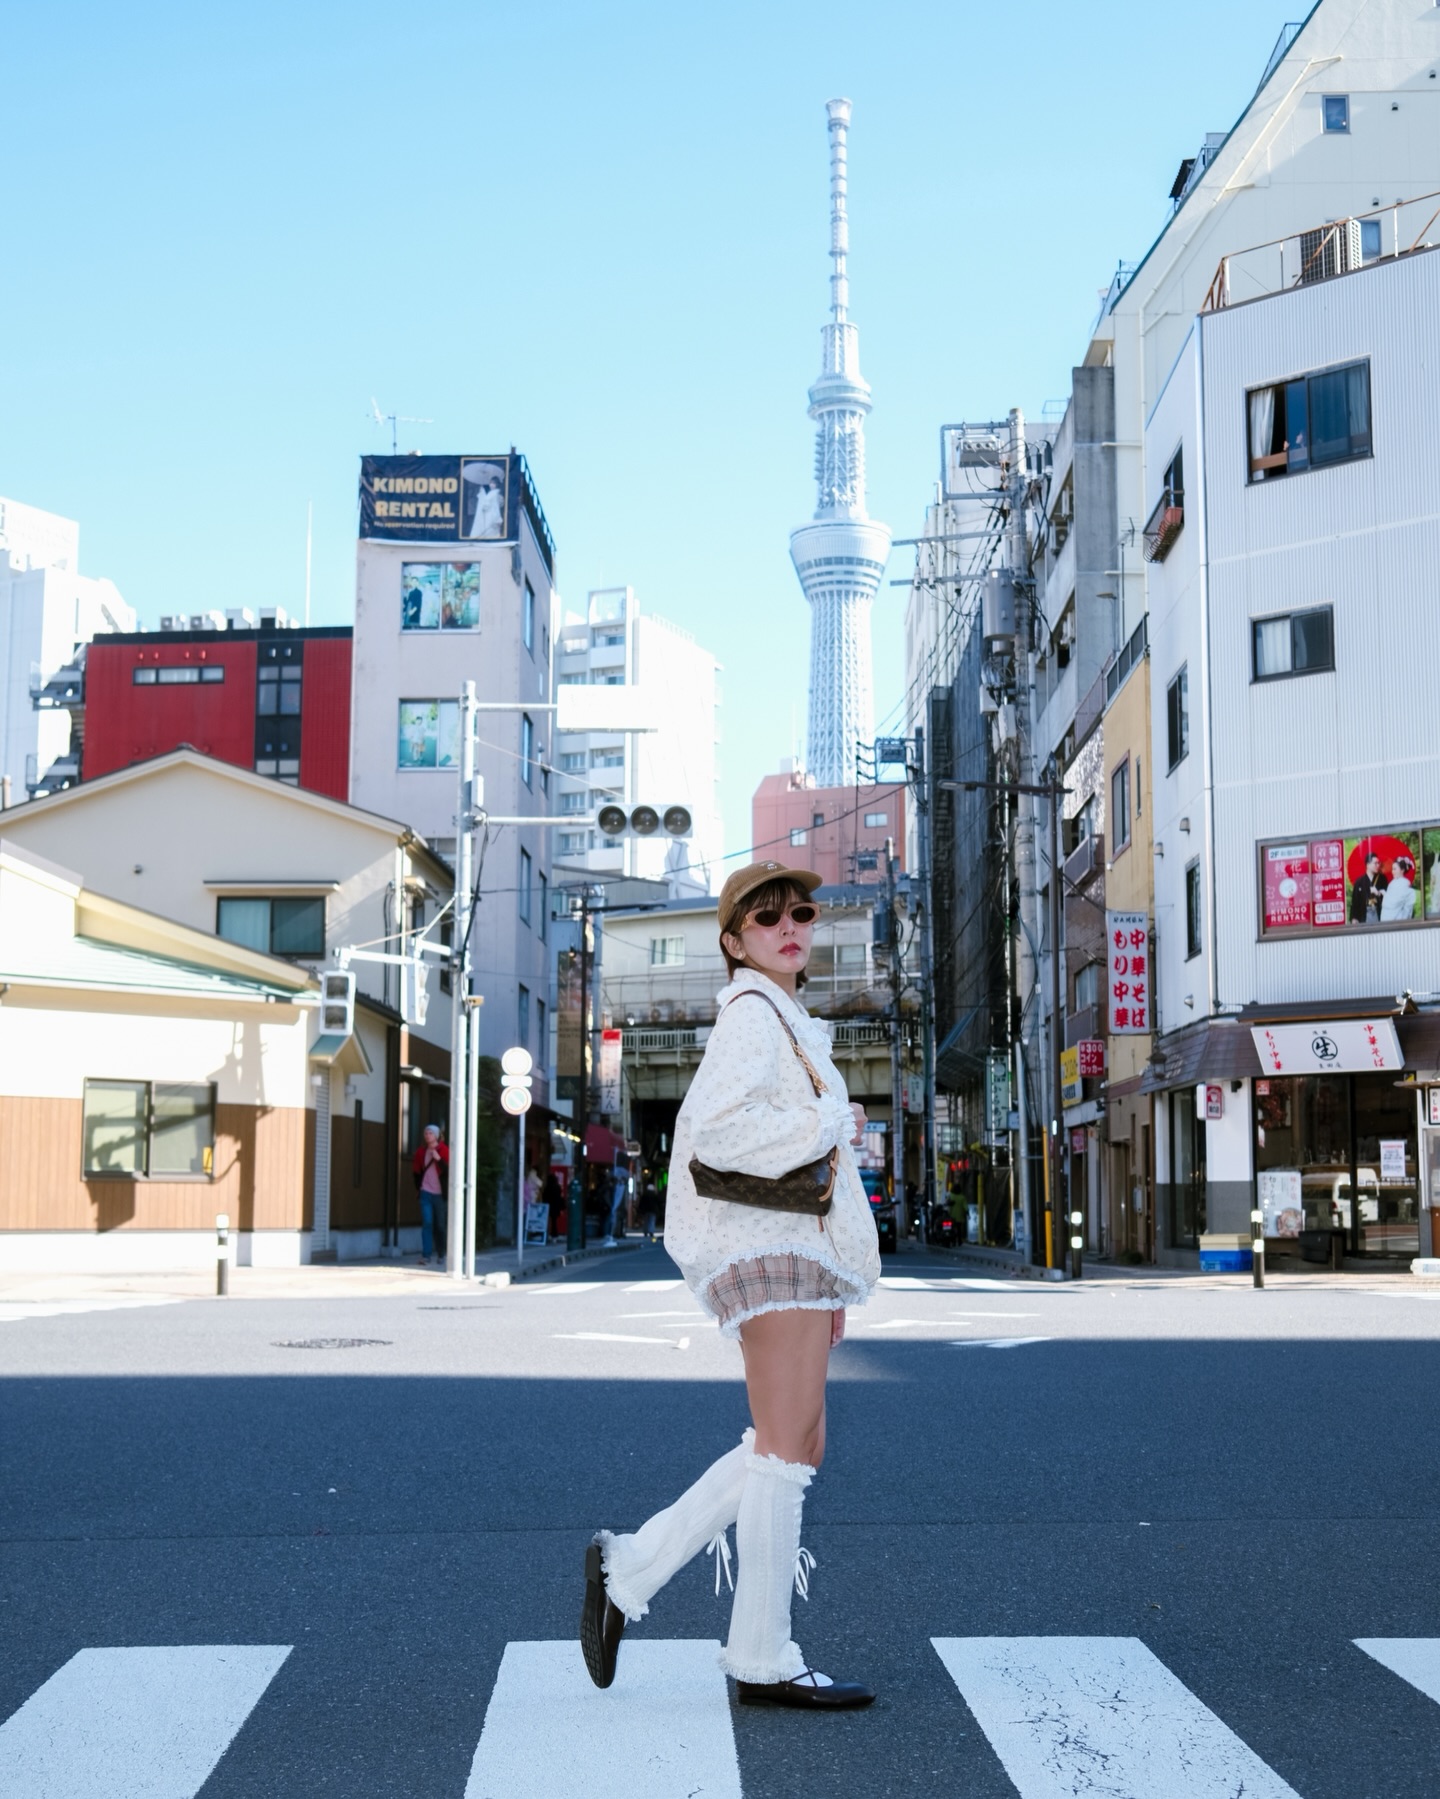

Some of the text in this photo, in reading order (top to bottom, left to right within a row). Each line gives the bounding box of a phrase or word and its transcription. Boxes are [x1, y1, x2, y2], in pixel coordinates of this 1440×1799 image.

[373, 477, 458, 494] KIMONO
[375, 500, 455, 518] RENTAL
[384, 521, 424, 529] reservation
[425, 522, 455, 530] required
[1270, 850, 1279, 859] 2F
[1315, 883, 1343, 892] English
[1271, 906, 1307, 915] KIMONO
[1271, 913, 1306, 922] RENTAL
[1113, 929, 1129, 1029] もり中華
[1130, 927, 1146, 1029] 中華そば
[1265, 1029, 1283, 1071] もり中華
[1364, 1023, 1385, 1068] 中華そば
[1080, 1053, 1097, 1063] コイン
[1081, 1064, 1103, 1074] ロッカー
